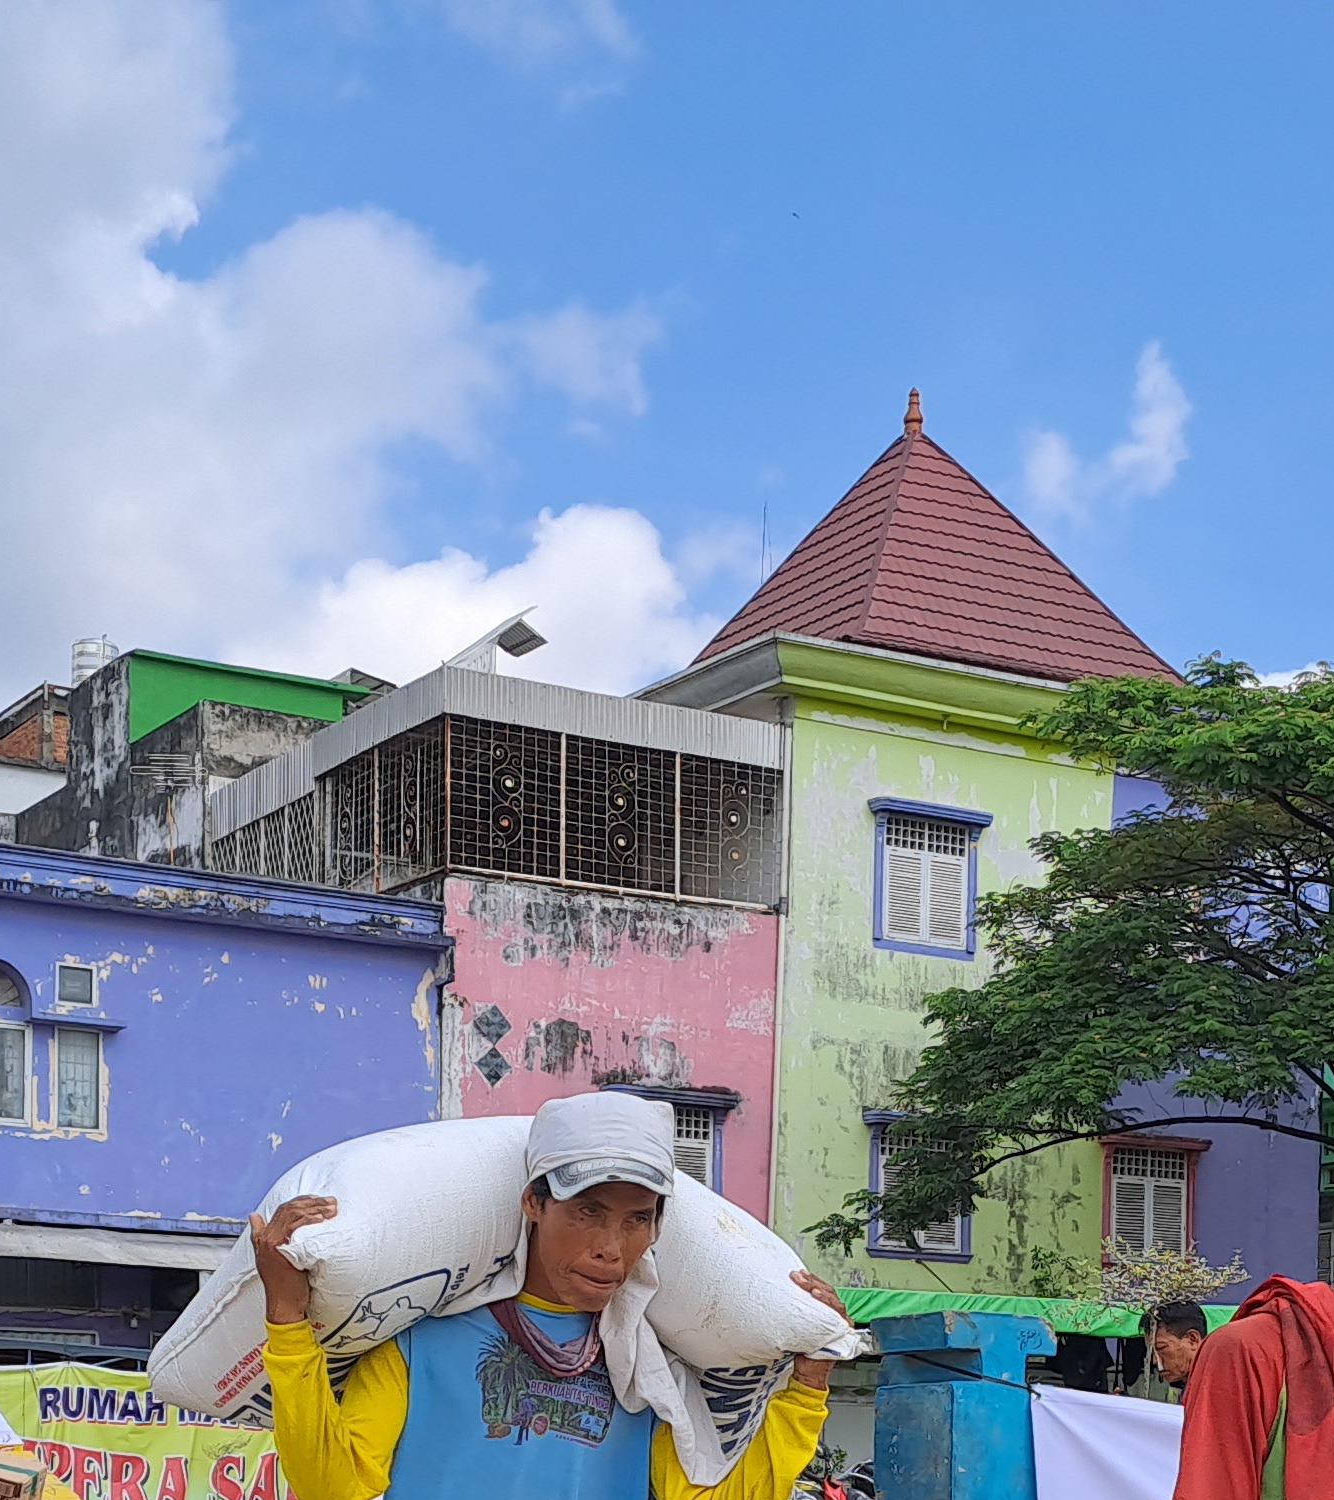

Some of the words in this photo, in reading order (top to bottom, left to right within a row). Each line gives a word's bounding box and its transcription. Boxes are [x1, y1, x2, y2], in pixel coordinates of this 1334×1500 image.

[454, 1263, 471, 1292] Telp
[38, 1386, 167, 1425] RUMAH
[530, 1381, 586, 1403] BERKUALITAS
